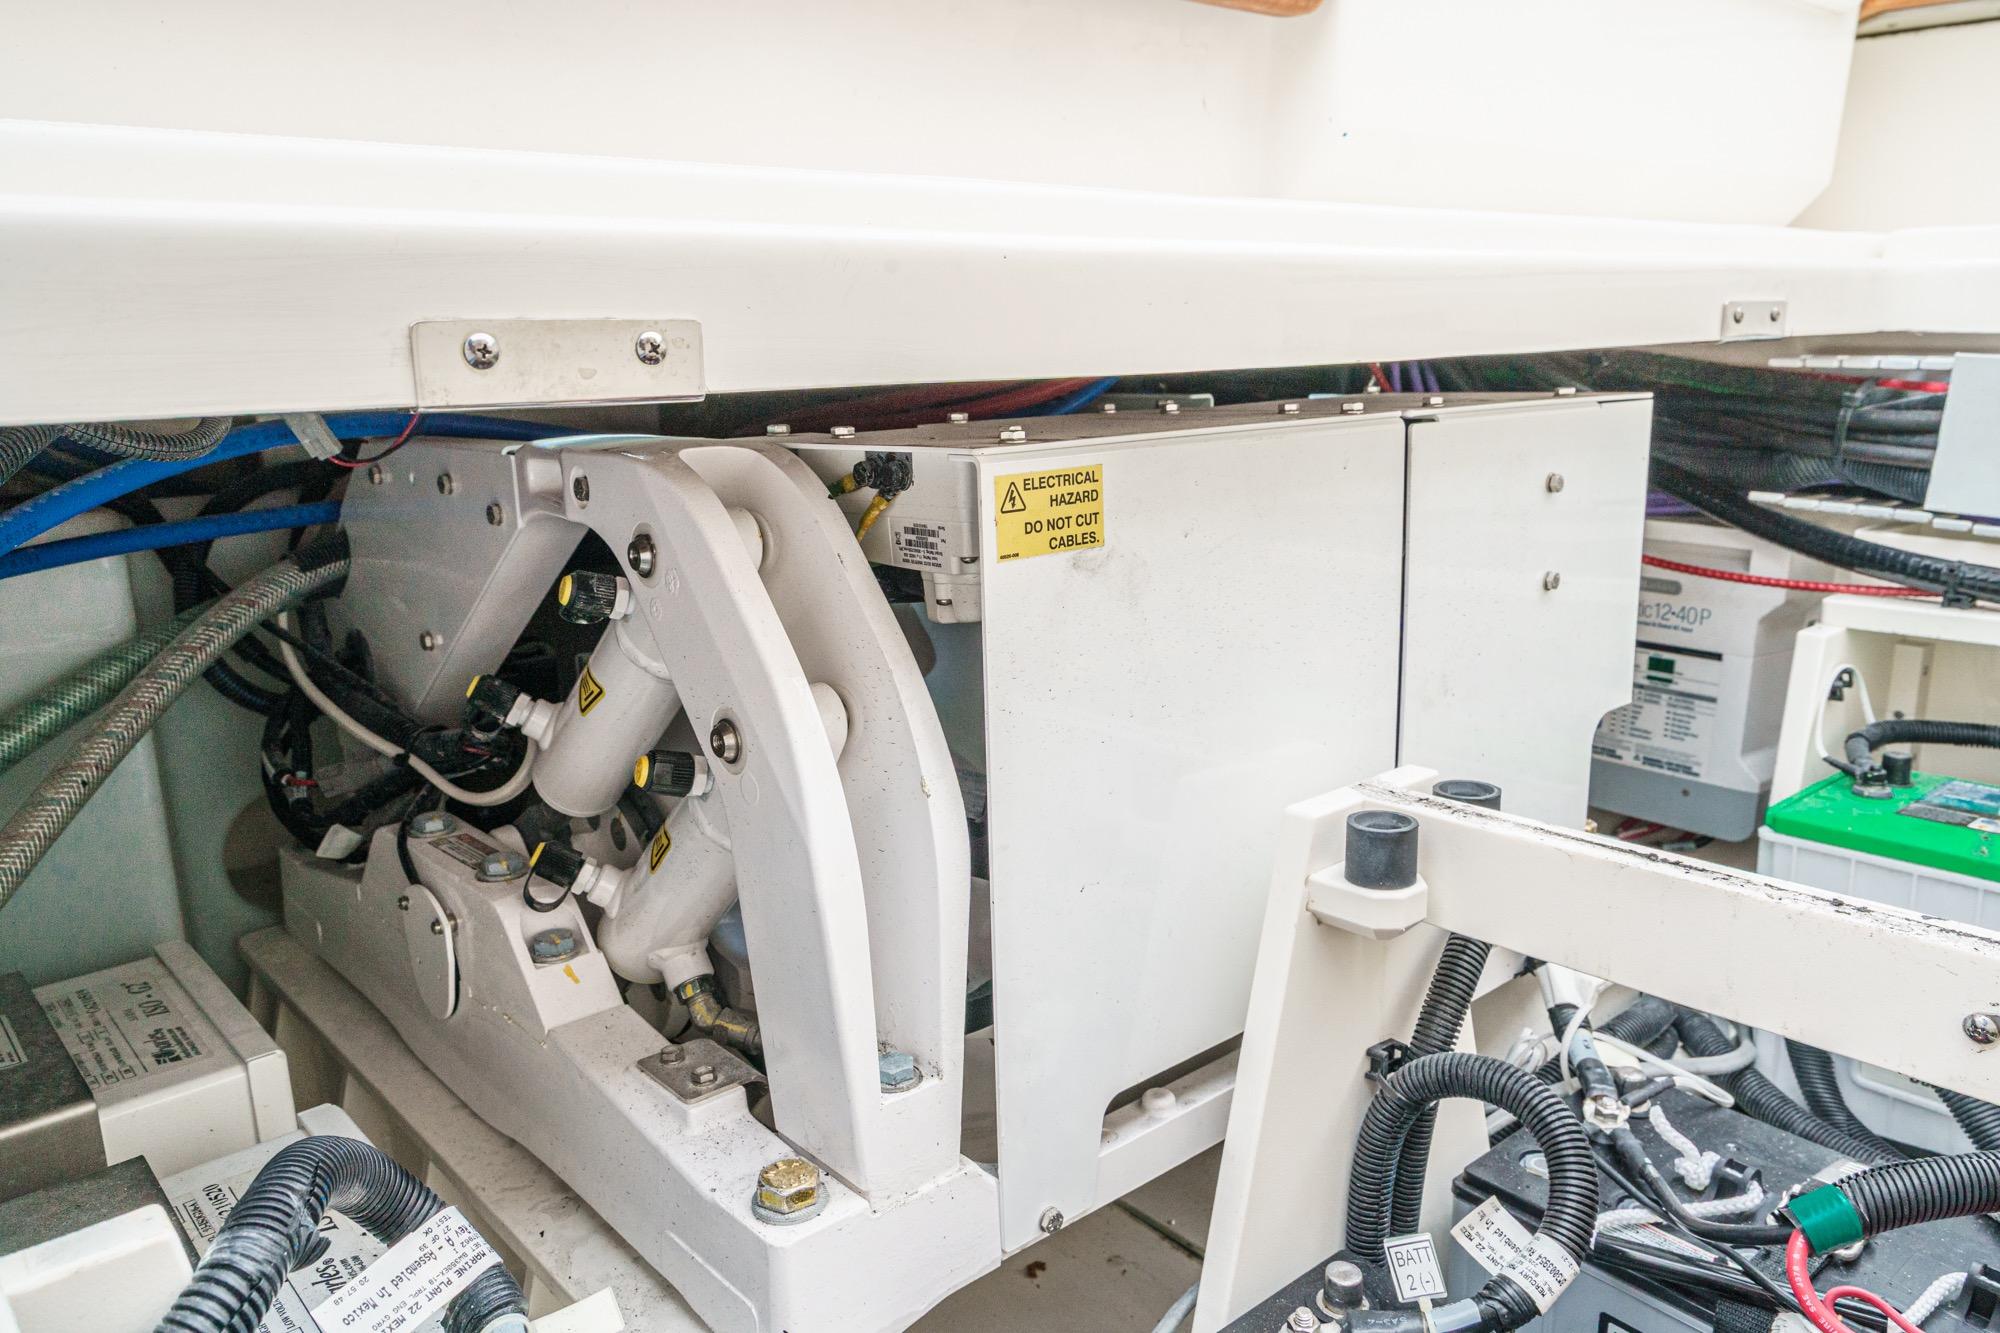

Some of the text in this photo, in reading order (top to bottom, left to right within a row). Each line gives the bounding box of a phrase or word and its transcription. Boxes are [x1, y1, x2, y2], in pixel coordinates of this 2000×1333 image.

[1024, 470, 1098, 491] ELECTRICAL
[1050, 490, 1098, 508] HAZARD
[1024, 512, 1100, 534] DO NOT CUT
[1048, 531, 1100, 550] CABLES.
[201, 1182, 234, 1220] 210520
[422, 1213, 451, 1237] TEST OK
[454, 1223, 470, 1240] Rev
[1485, 1218, 1494, 1230] In
[418, 1225, 452, 1253] 27 OF 39
[444, 1236, 455, 1248] A
[1475, 1242, 1486, 1252] 22
[454, 1249, 487, 1279] MARINE
[1394, 1246, 1431, 1267] BATT
[1486, 1253, 1504, 1271] LANT
[390, 1249, 438, 1291] Assembled
[424, 1276, 453, 1302] PLANT
[1519, 1270, 1548, 1298] MERCURY
[376, 1286, 392, 1302] In
[1802, 1294, 1816, 1312] SAE
[341, 1297, 377, 1327] Mexico
[392, 1300, 407, 1315] ENG
[408, 1301, 423, 1315] 22
[282, 1316, 295, 1329] LOW
[371, 1314, 391, 1331] GYRO
